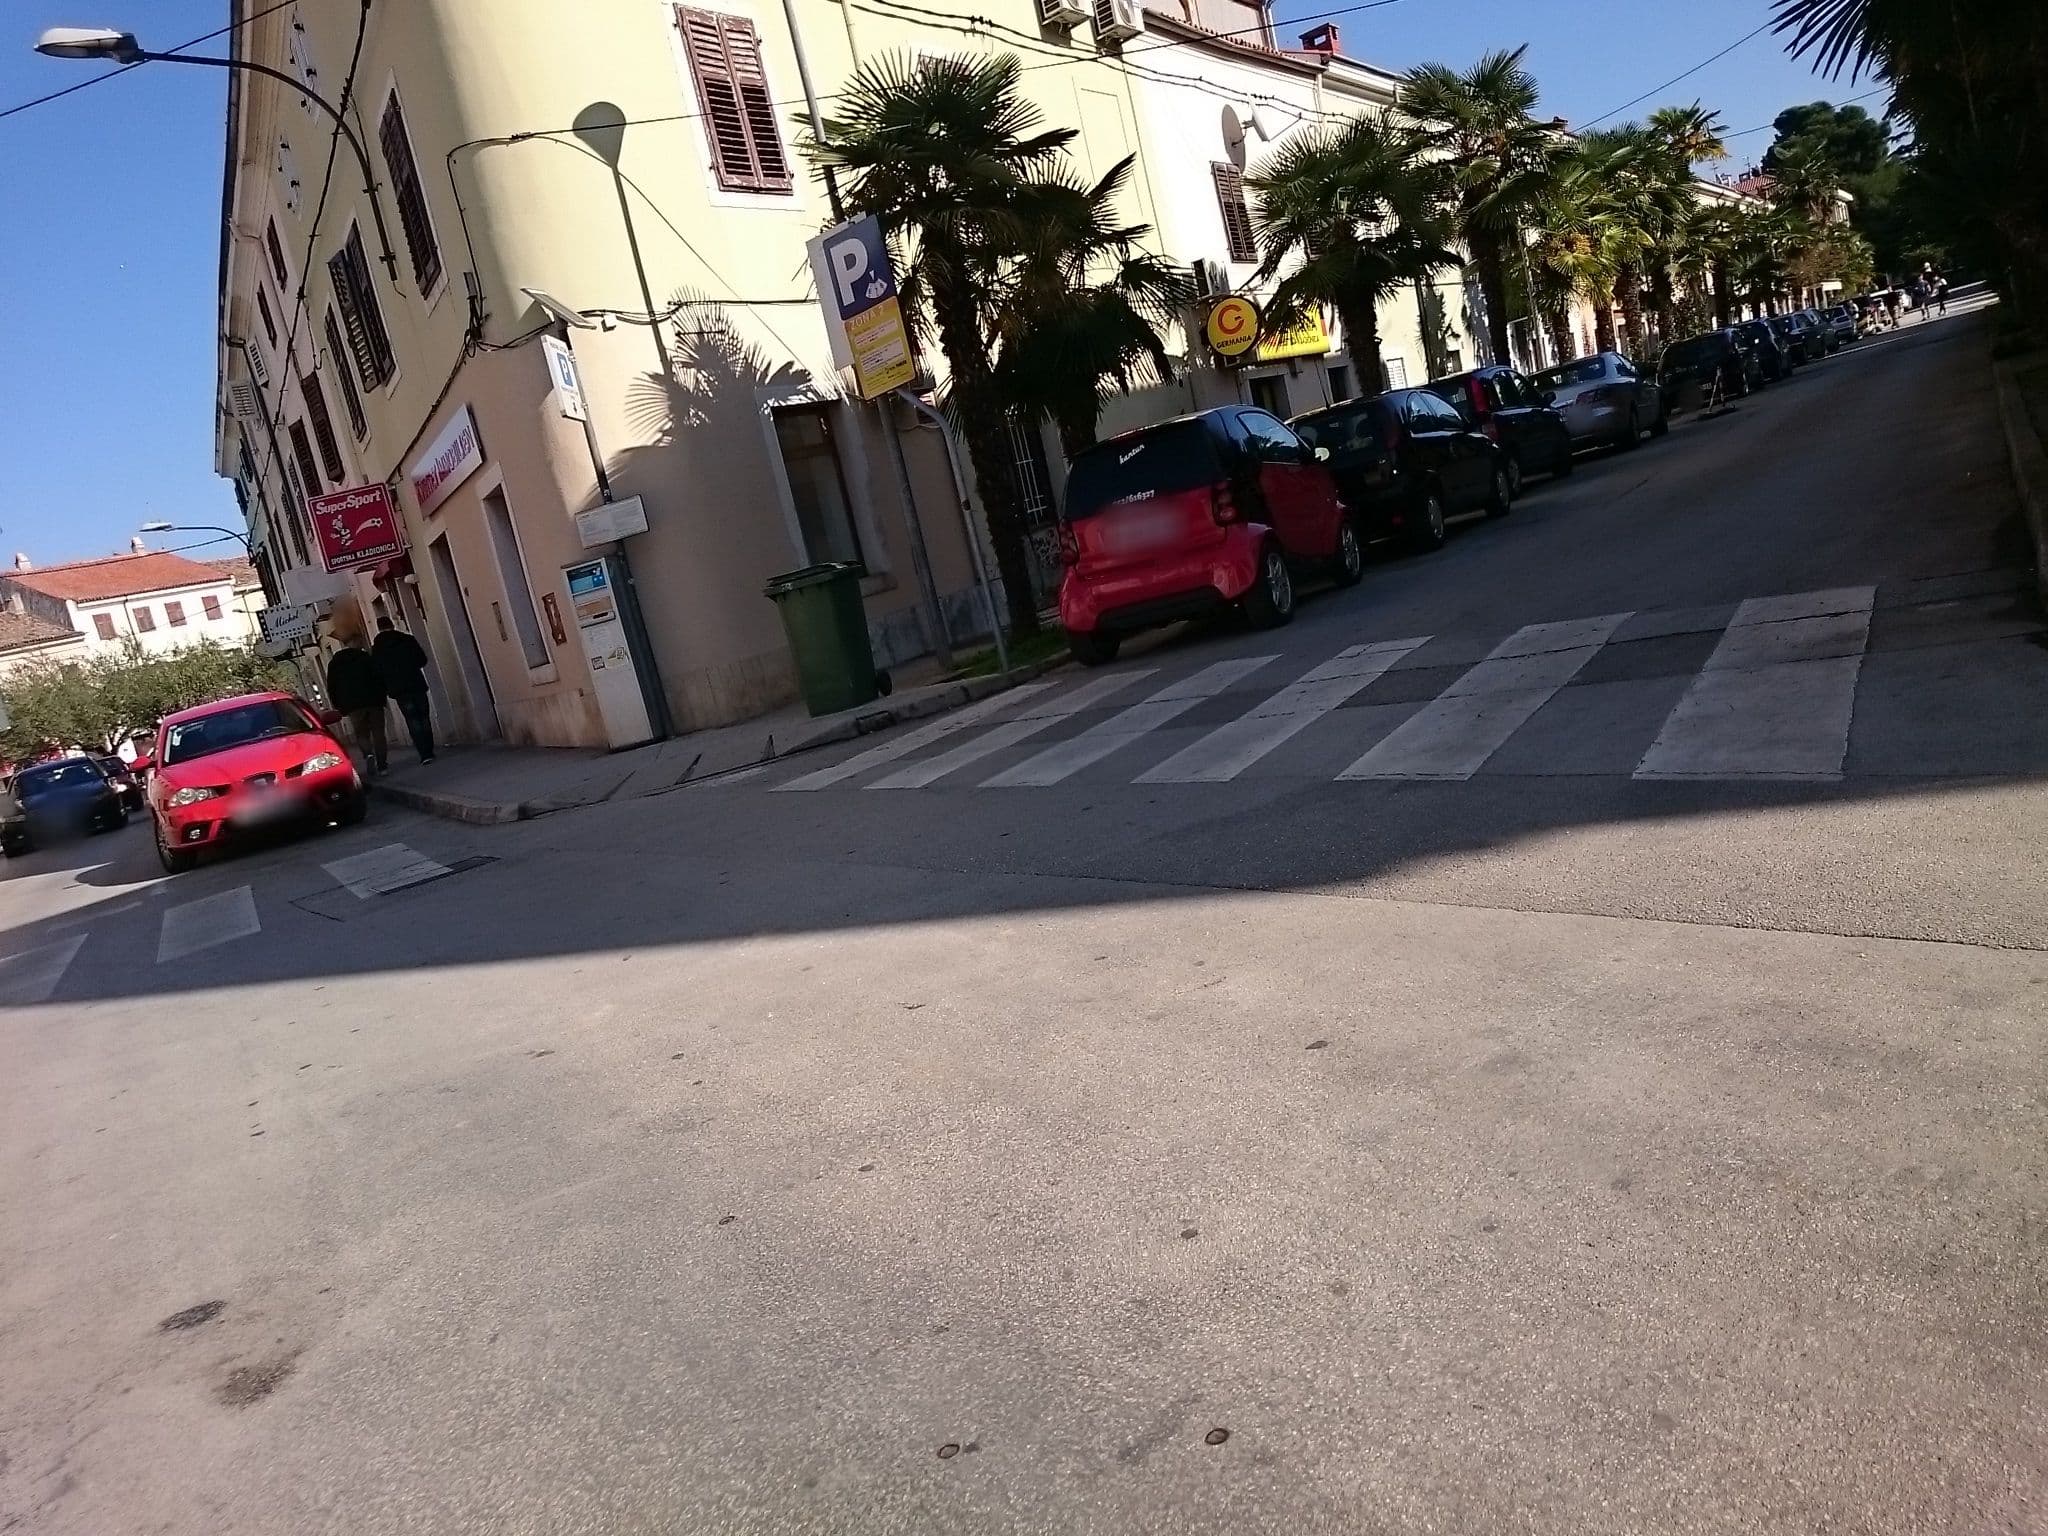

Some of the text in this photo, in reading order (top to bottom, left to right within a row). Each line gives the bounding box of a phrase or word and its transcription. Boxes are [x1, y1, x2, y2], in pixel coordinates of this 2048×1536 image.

[829, 238, 869, 307] P
[1216, 335, 1252, 349] GERMANIA
[316, 490, 381, 515] SuperSport
[356, 543, 396, 559] KLADIONICA
